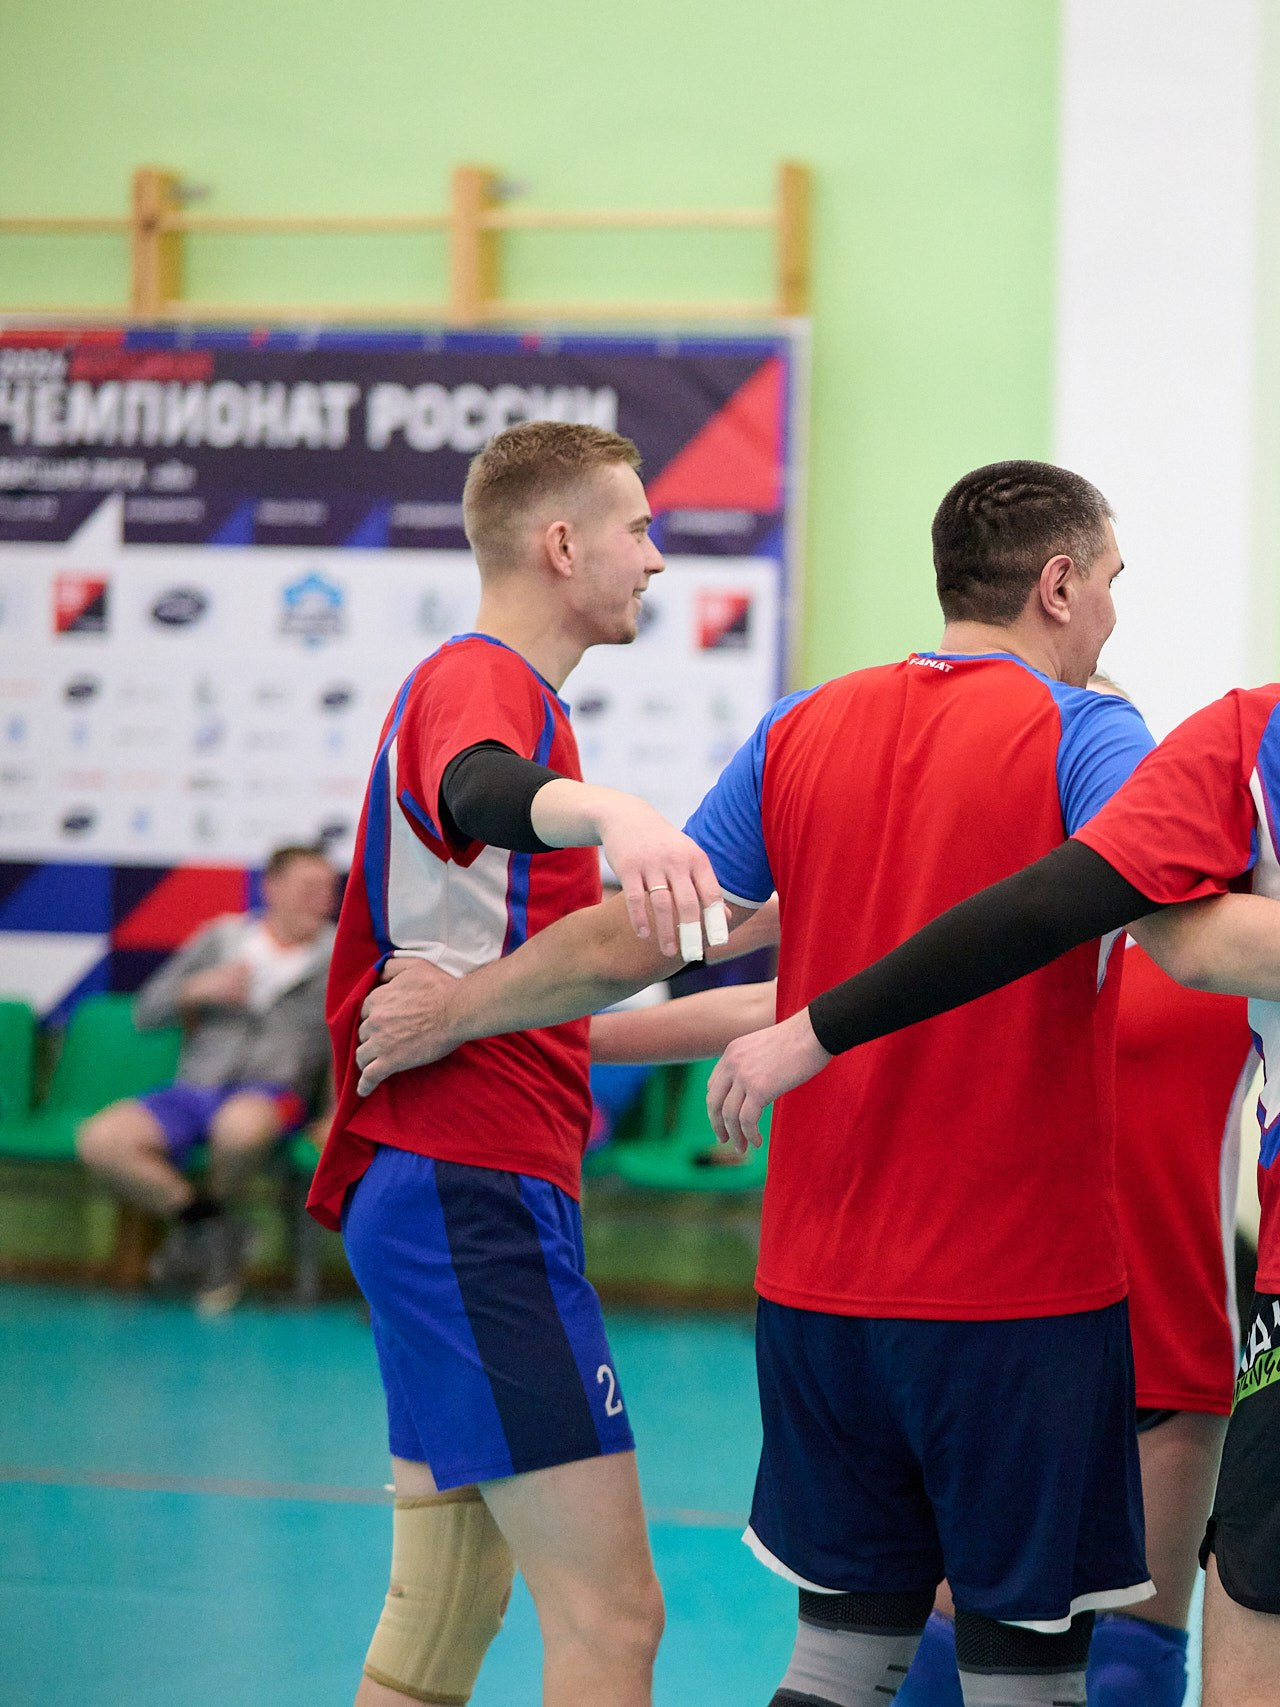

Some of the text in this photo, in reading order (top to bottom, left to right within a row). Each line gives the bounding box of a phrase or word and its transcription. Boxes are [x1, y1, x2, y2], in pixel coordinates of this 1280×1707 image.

[0, 379, 361, 449] ЧЕМПИОНАТ
[908, 658, 955, 673] FANAT
[596, 1363, 623, 1417] 2
